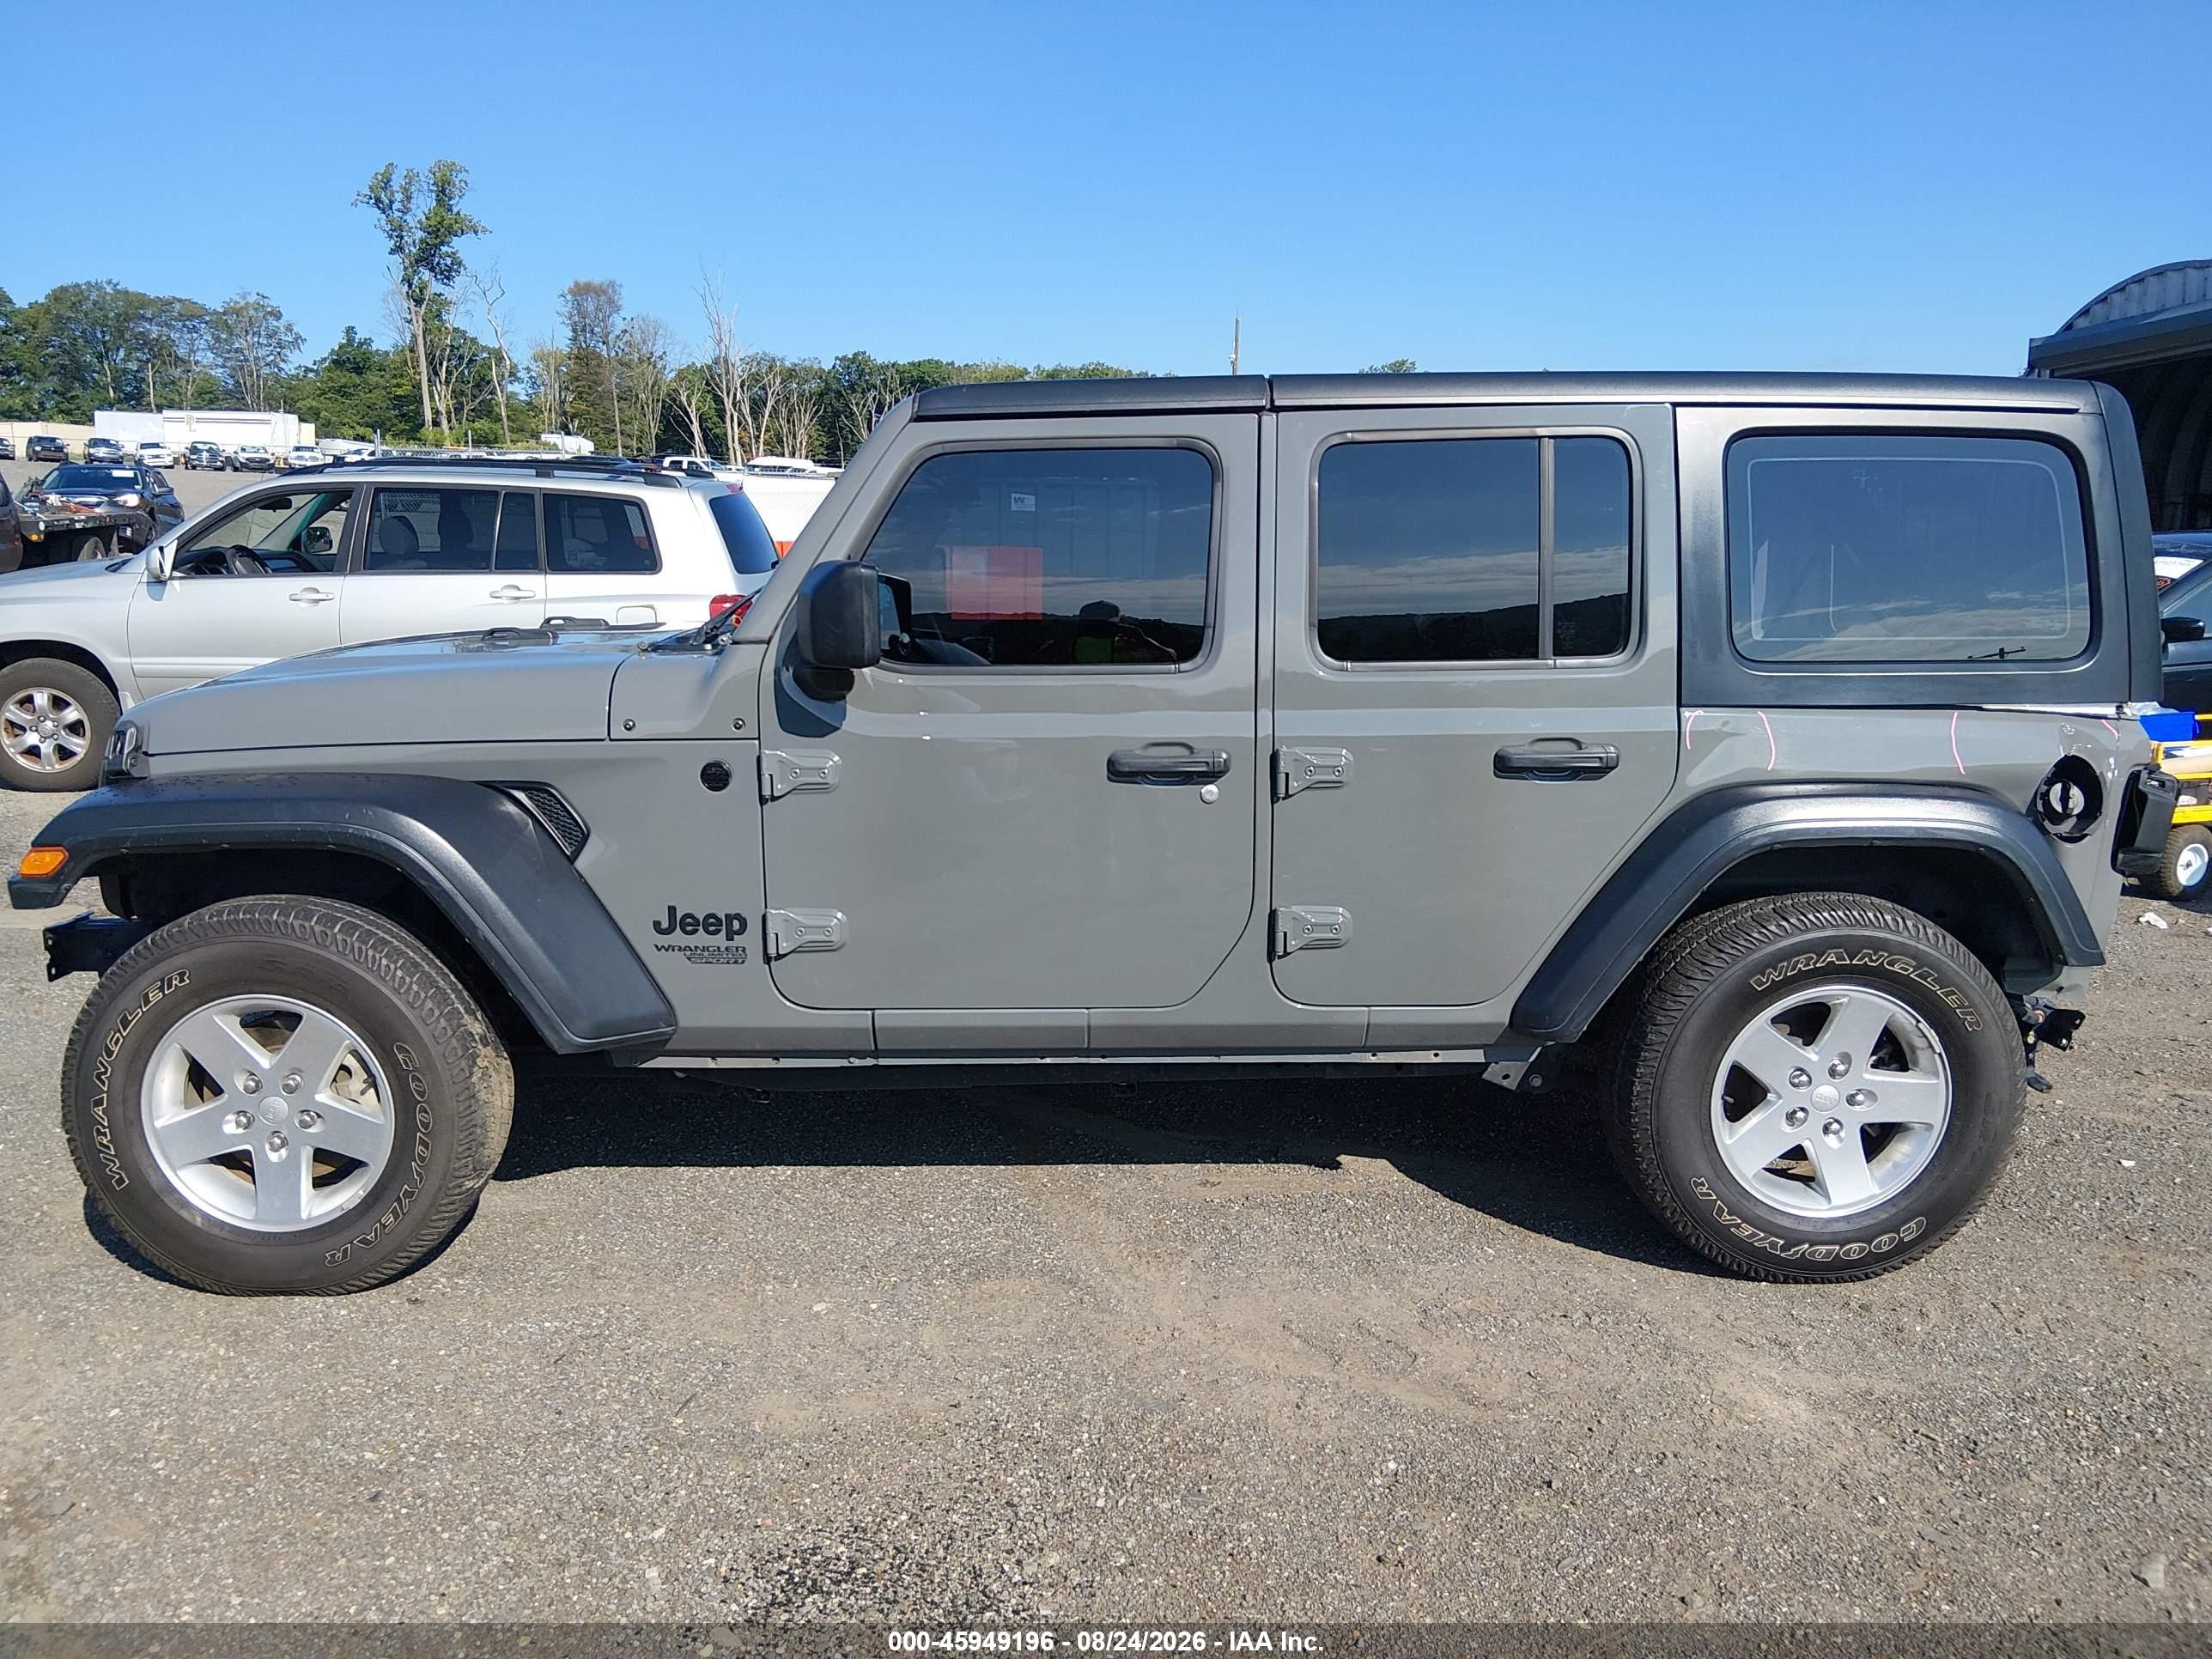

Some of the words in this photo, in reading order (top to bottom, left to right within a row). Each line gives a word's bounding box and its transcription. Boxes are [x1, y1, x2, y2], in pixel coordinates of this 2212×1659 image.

[653, 905, 747, 941] Jeep
[653, 944, 746, 953] WRANGLER
[1749, 948, 1983, 1031] WRANGLER
[91, 969, 191, 1191] WRANGLER
[325, 1042, 433, 1267] GOODYEAR
[1690, 1176, 1927, 1261] GOODYEAR
